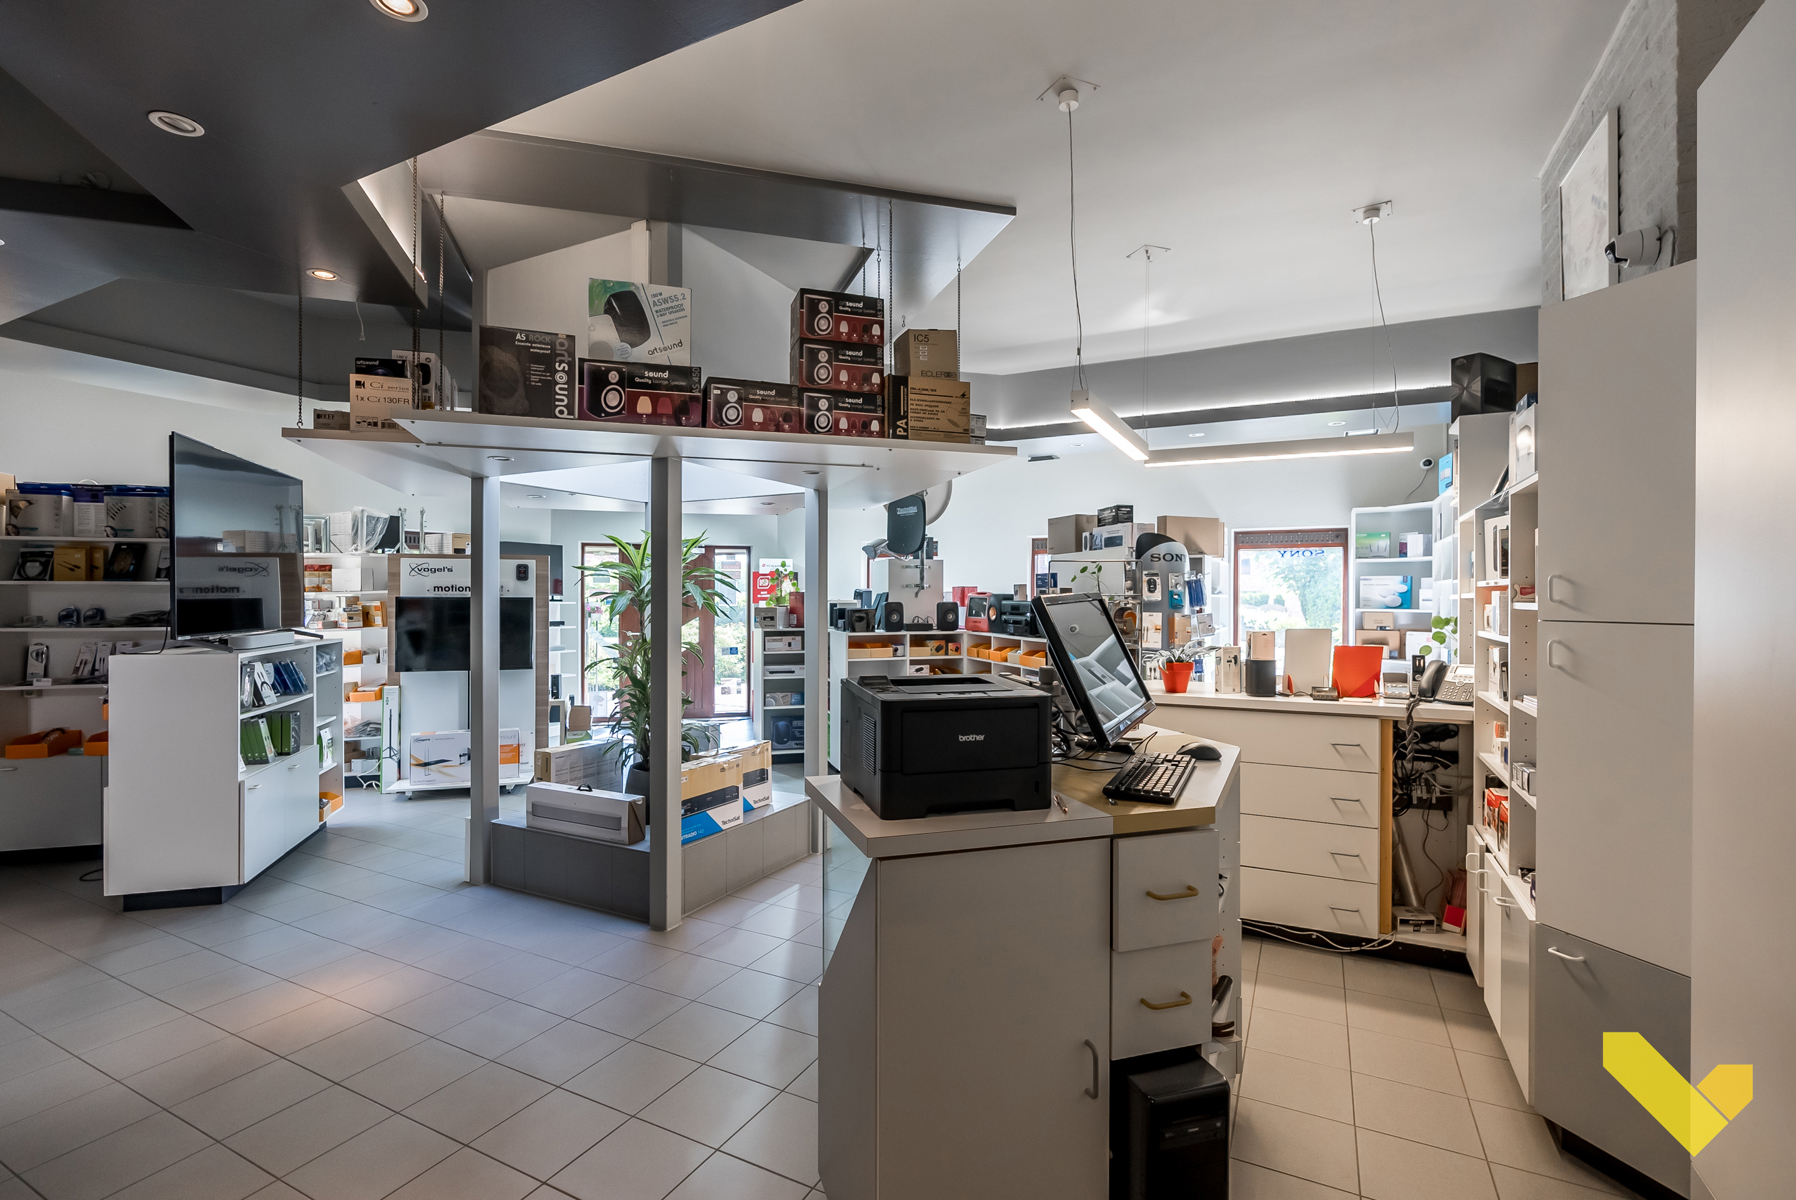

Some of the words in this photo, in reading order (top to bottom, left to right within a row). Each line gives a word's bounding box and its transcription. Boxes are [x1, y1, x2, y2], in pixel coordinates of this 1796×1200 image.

[528, 334, 552, 343] ROCK
[913, 333, 930, 343] IC5
[647, 338, 684, 356] artsound
[554, 338, 574, 419] artsound
[634, 376, 652, 384] Quality
[692, 367, 700, 383] 450
[369, 381, 385, 389] Ci
[355, 394, 365, 402] 1x
[383, 396, 410, 405] 130FR
[896, 418, 907, 436] PA
[416, 566, 454, 574] vogel's
[958, 733, 985, 742] brother
[752, 795, 770, 805] TechniSat
[721, 815, 741, 826] TechniSat
